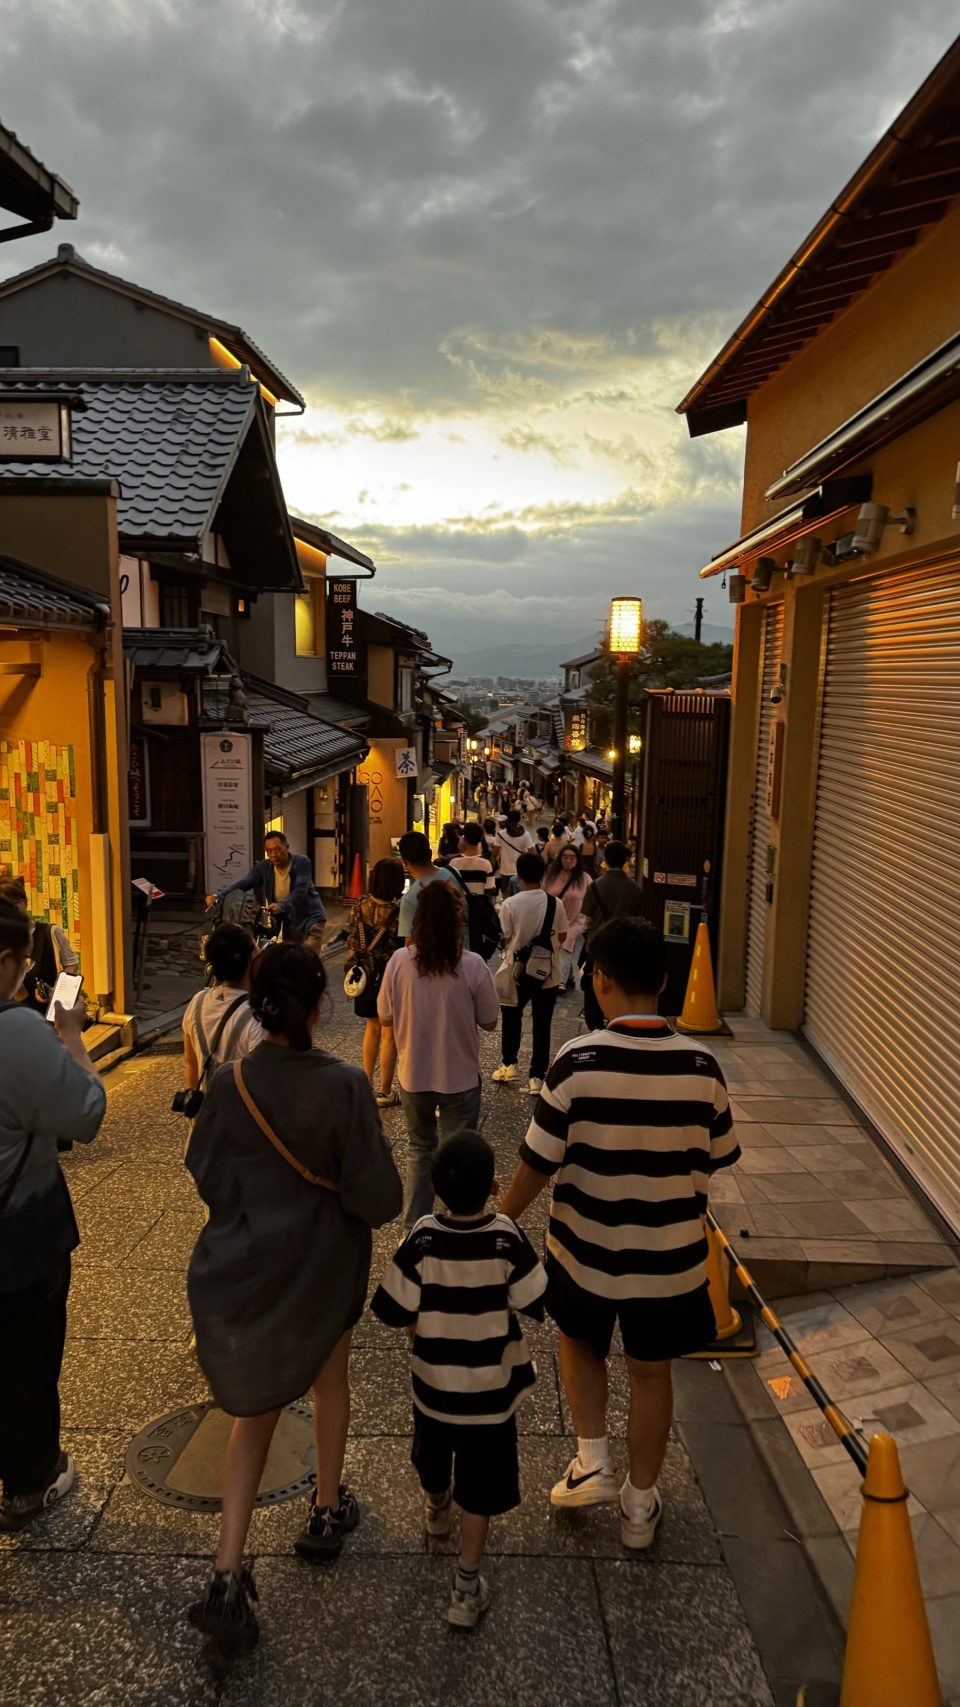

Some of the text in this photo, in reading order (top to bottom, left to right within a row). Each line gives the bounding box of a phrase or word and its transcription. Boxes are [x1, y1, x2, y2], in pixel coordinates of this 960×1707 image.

[3, 425, 53, 442] 清雅堂
[333, 583, 352, 593] KOBE
[333, 594, 351, 603] BEEF
[340, 608, 354, 648] 神戸牛
[330, 651, 357, 661] TEPPAN
[332, 662, 355, 671] STEAK
[397, 750, 416, 775] 茶
